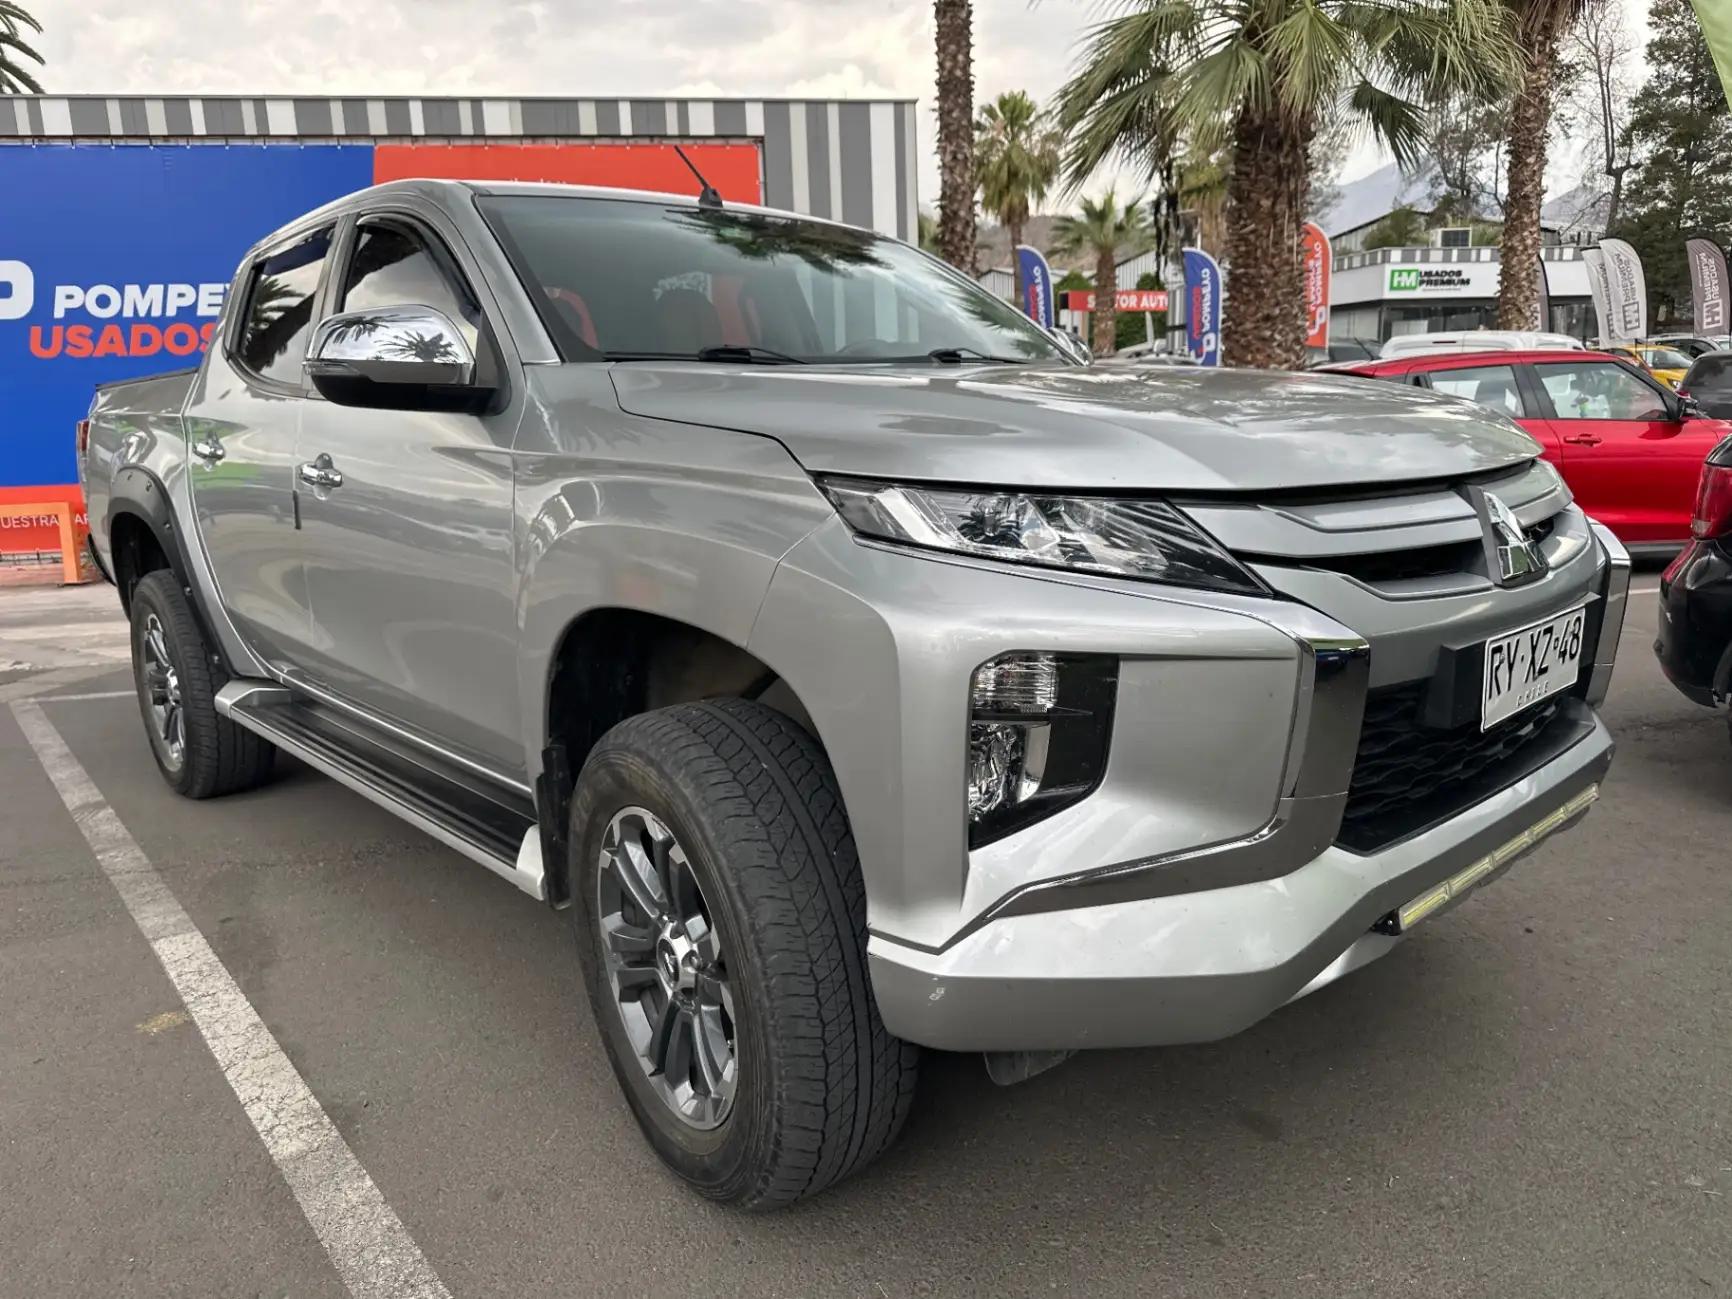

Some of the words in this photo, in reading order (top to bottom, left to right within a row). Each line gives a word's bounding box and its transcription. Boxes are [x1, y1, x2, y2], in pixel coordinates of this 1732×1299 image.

[1420, 270, 1462, 278] USADOS
[1419, 278, 1470, 287] PREMIUM
[53, 283, 229, 318] POMPE
[0, 514, 59, 529] UESTRA
